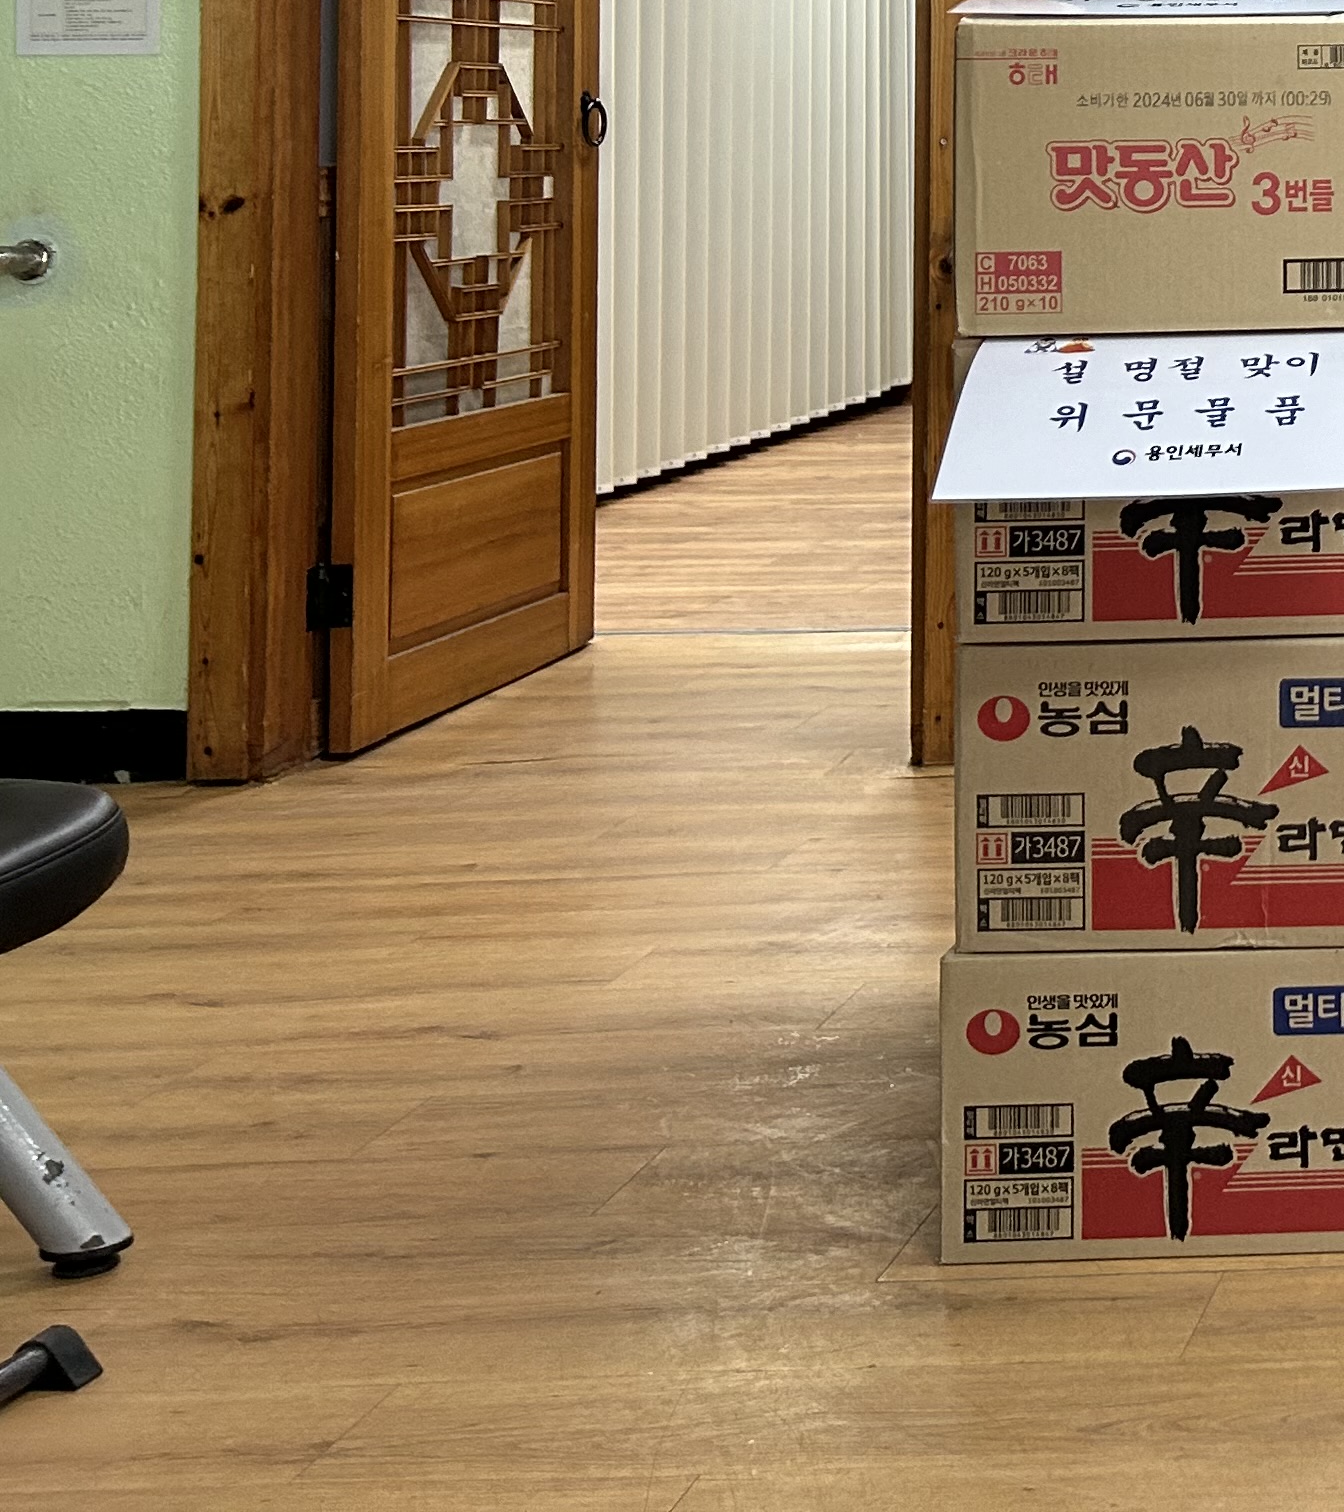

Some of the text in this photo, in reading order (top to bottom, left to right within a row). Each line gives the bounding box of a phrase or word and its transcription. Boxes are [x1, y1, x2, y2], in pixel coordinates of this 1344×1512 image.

[1076, 89, 1332, 108] 소비기한 2024년 06월 30일 까지 (00:29)
[1048, 139, 1237, 210] 맛동산
[1251, 171, 1335, 216] 3번들
[980, 254, 1048, 271] C 7063
[980, 274, 1058, 291] H 050332
[1053, 351, 1320, 385] 설 명절 맞이
[1144, 442, 1244, 462] 용인세무서
[1012, 528, 1082, 554] 가3487
[1037, 679, 1130, 697] 인생을 맛있게
[1037, 700, 1130, 737] 농심
[1289, 755, 1311, 778] 신
[1119, 725, 1280, 934] 辛
[1014, 835, 1082, 861] 가3487
[1026, 993, 1119, 1011] 인생을 맛있게
[1026, 1012, 1119, 1050] 농심
[1280, 1065, 1303, 1088] 신
[1108, 1036, 1271, 1242] 辛
[1002, 1145, 1071, 1171] 가3487
